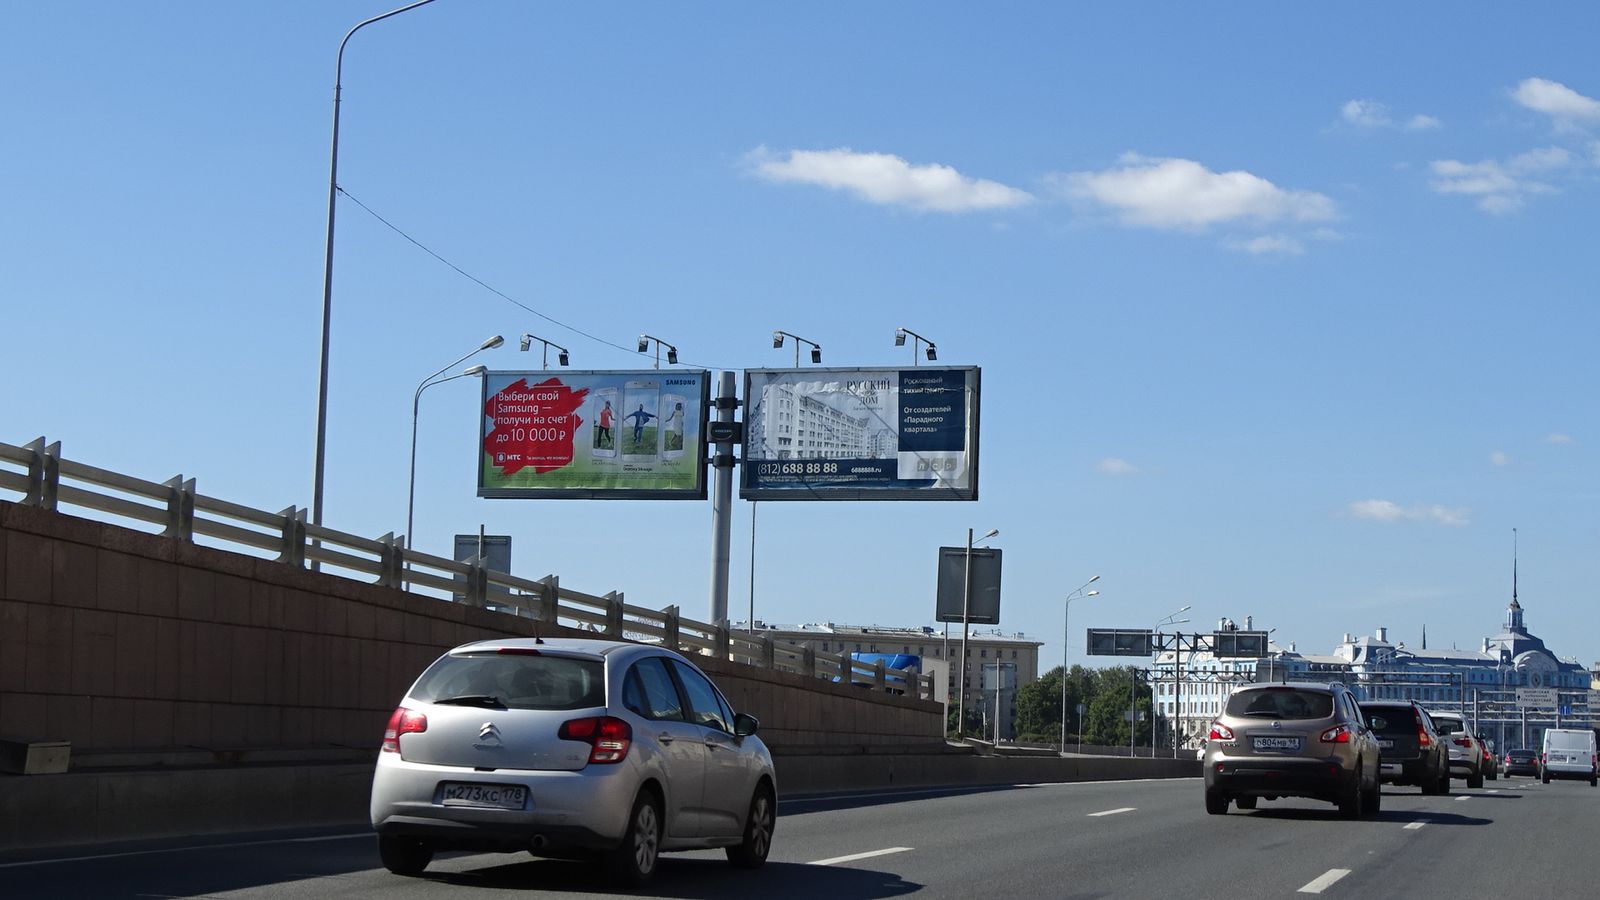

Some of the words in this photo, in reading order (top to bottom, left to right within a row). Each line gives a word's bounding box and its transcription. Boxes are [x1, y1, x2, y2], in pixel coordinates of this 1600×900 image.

[846, 378, 890, 390] РУССКИЙ
[498, 391, 534, 403] Выбери
[536, 390, 559, 401] свой
[859, 396, 879, 405] ДОМ
[498, 403, 539, 414] Samsung
[913, 406, 951, 415] создателей
[497, 416, 531, 426] получи
[547, 416, 568, 424] счет
[904, 416, 943, 424] «Парадного
[496, 434, 509, 443] до
[511, 428, 525, 441] 10
[529, 428, 557, 441] 000
[904, 426, 938, 434] квартала»
[758, 463, 780, 475] (812)
[782, 463, 803, 474] 688
[806, 463, 820, 474] 88
[823, 463, 838, 474] 88
[446, 785, 499, 801] М273КС
[501, 788, 522, 800] 178
